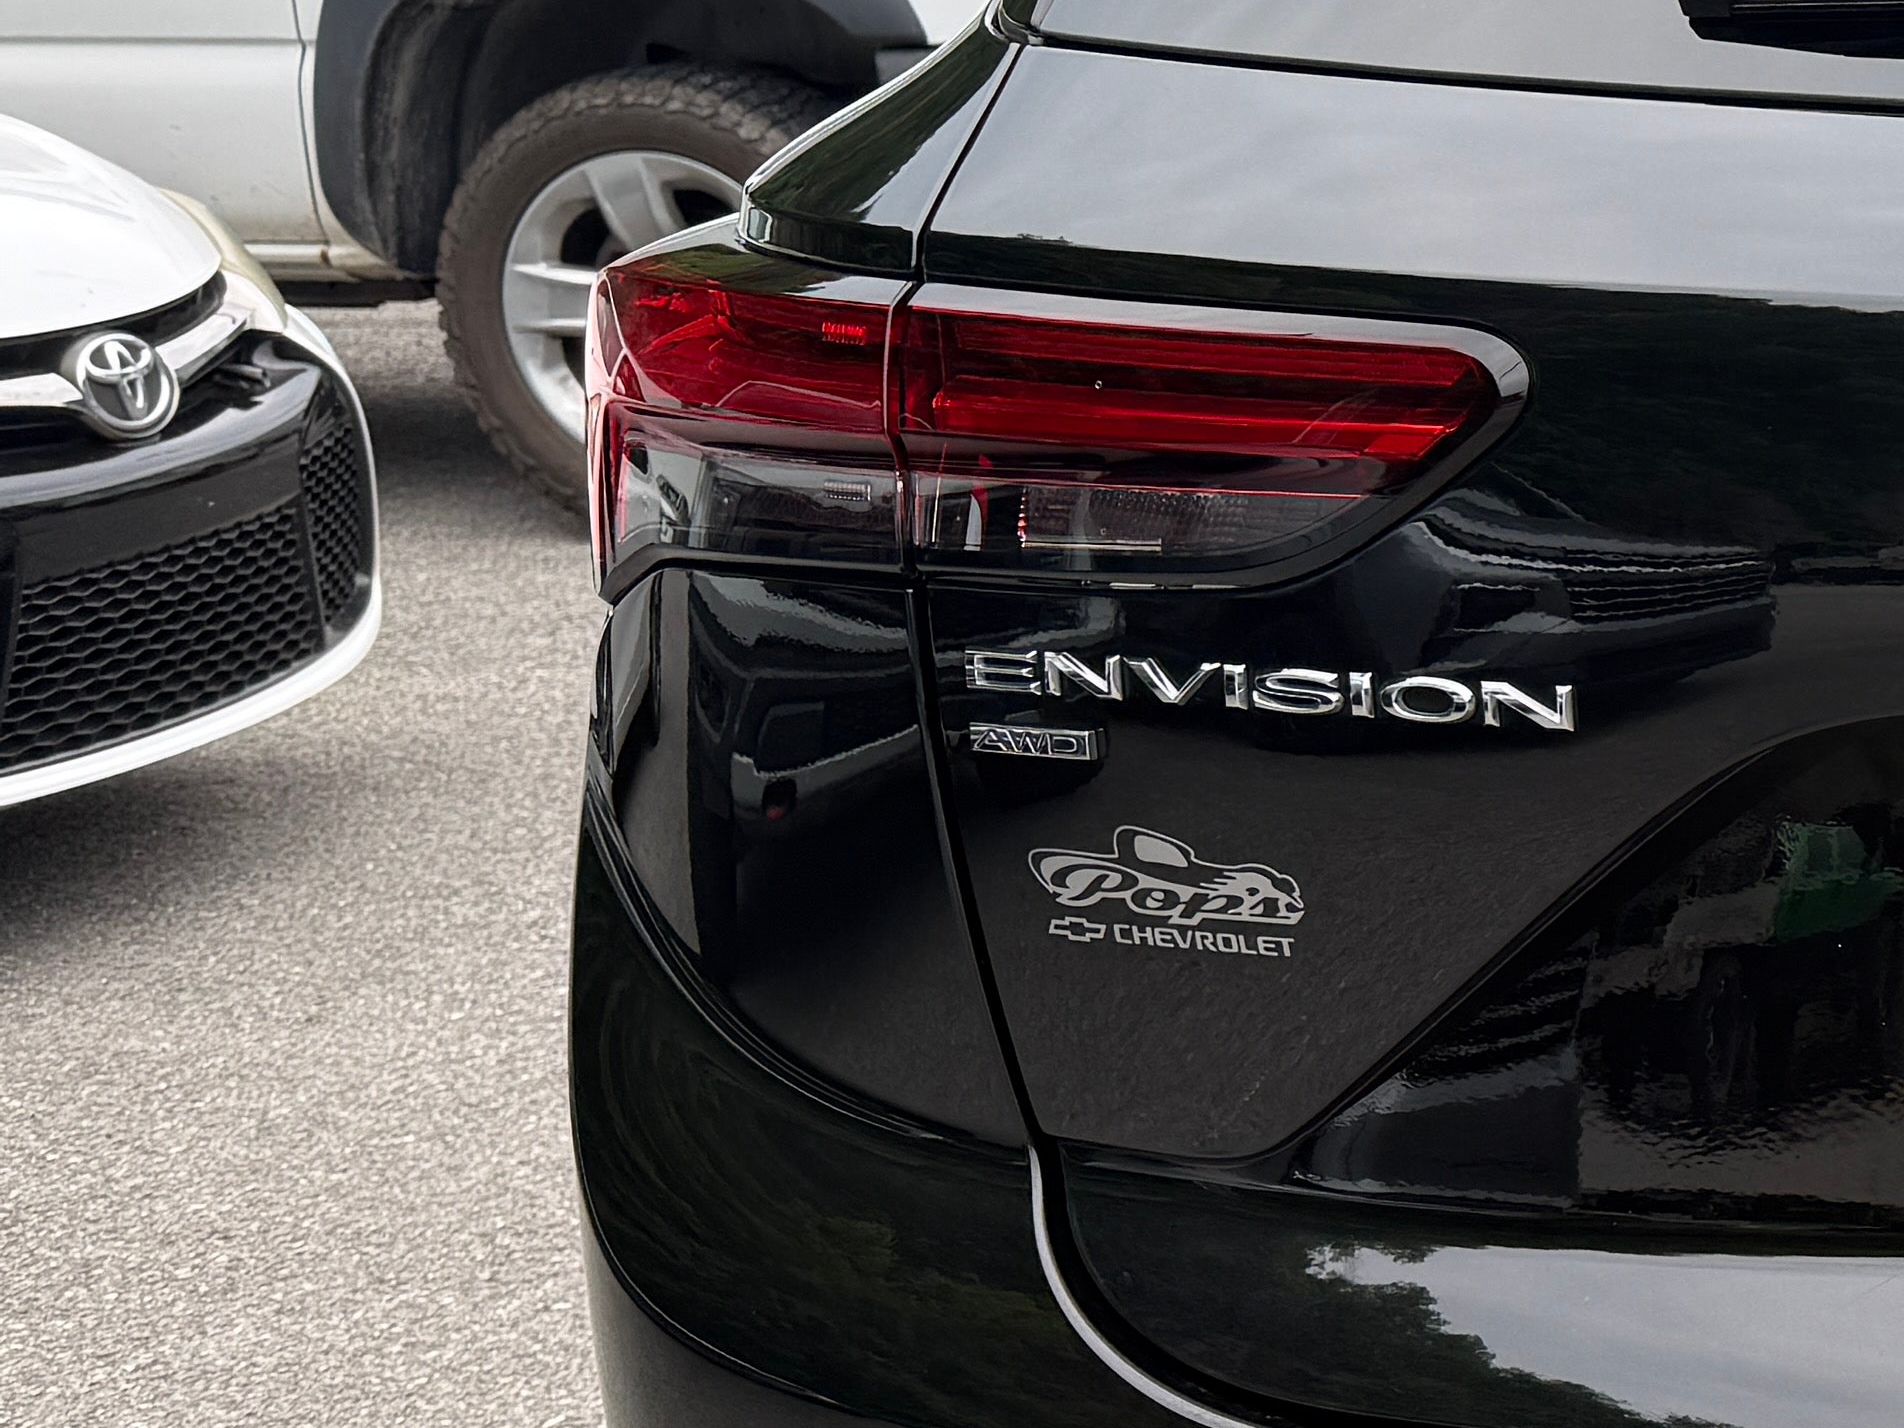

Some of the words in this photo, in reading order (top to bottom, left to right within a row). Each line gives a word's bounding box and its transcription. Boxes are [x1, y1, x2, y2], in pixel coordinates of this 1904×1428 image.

[964, 649, 1576, 733] ENVISION
[972, 728, 1084, 757] AWD
[1113, 923, 1295, 957] CHEVROLET
